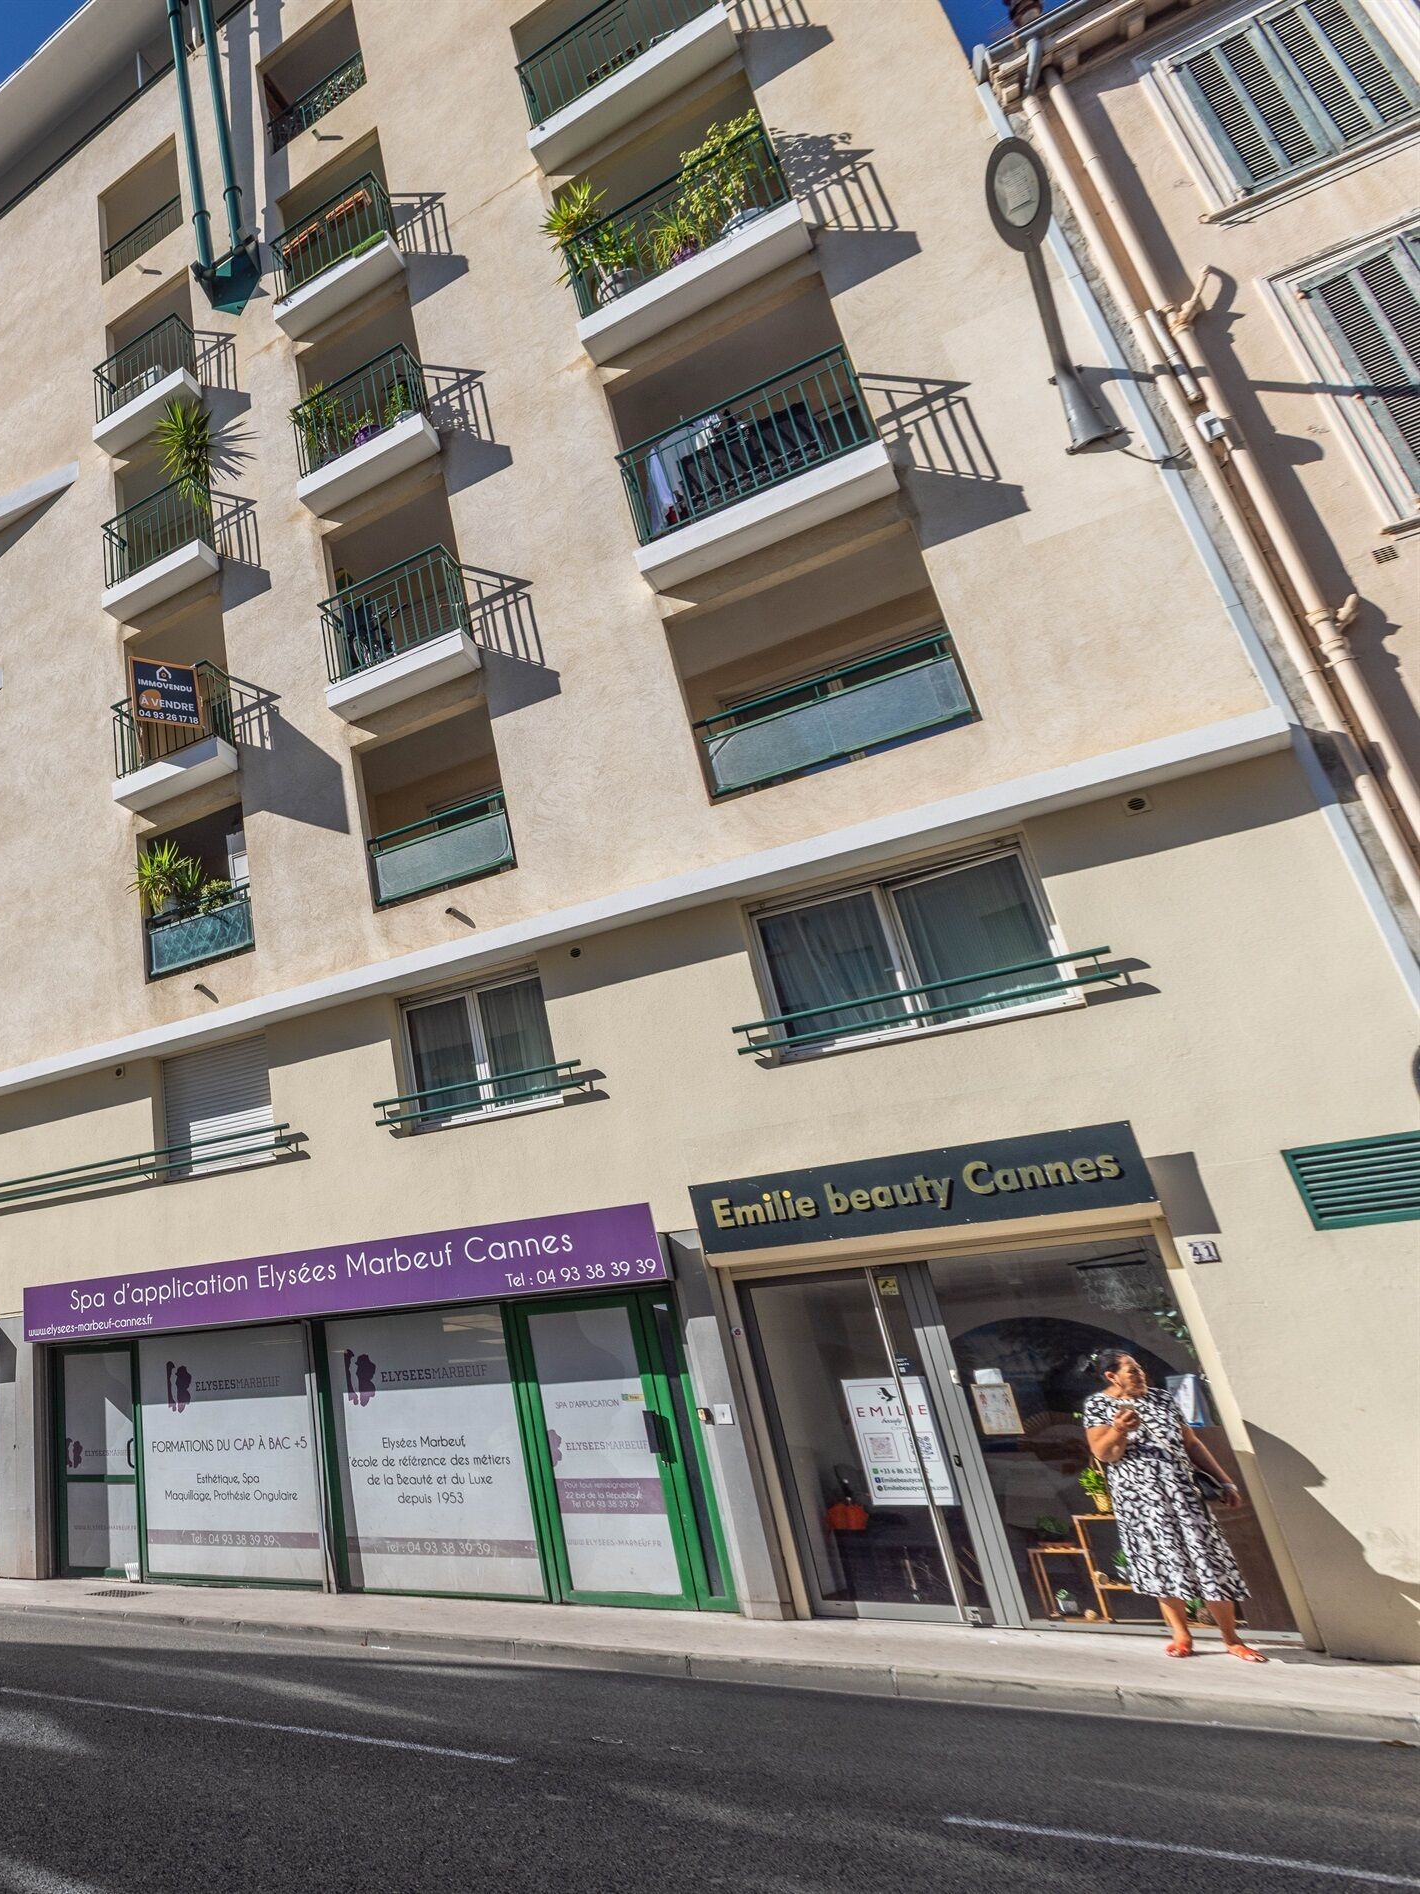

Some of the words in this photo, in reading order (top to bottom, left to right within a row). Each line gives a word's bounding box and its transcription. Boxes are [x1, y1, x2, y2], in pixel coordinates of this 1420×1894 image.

[138, 678, 192, 692] IMMOVENDU
[141, 694, 148, 705] À
[151, 698, 195, 712] VENDRE
[139, 709, 151, 718] 04
[152, 711, 164, 719] 93
[166, 713, 177, 721] 26
[189, 716, 198, 724] 18
[711, 1190, 816, 1228] Emilie
[824, 1174, 950, 1214] beauty
[962, 1154, 1120, 1194] Cannes
[1192, 1245, 1216, 1259] 41
[70, 1289, 105, 1313] Spa
[114, 1274, 248, 1306] d'application
[258, 1263, 336, 1291] Elysées
[346, 1242, 452, 1277] Marbeuf
[464, 1234, 573, 1263] Cannes
[505, 1273, 524, 1288] Tel
[536, 1269, 556, 1284] 04
[560, 1266, 580, 1282] 93
[586, 1264, 605, 1279] 38
[610, 1261, 630, 1276] 39
[636, 1258, 656, 1274] 39
[28, 1314, 153, 1336] www.elysees-marbeuf-cannes.fr
[381, 1364, 488, 1383] ELYSEESMARBEUF
[195, 1375, 281, 1392] ELYSEESMARBEUF
[555, 1401, 568, 1409] SPA
[569, 1399, 620, 1409] D'APPLICATION
[856, 1404, 928, 1418] EMILIE
[152, 1439, 214, 1453] FORMATIONS
[217, 1439, 230, 1452] DU
[234, 1438, 255, 1451] CAP
[258, 1434, 266, 1450] À
[269, 1436, 291, 1450] BAC
[294, 1436, 308, 1449] +5
[382, 1437, 417, 1450] Elysées
[382, 1456, 395, 1467] de
[398, 1454, 446, 1467] référence
[450, 1454, 470, 1465] des
[473, 1454, 511, 1465] métiers
[196, 1473, 240, 1486] Esthétique,
[242, 1473, 260, 1485] Spa
[367, 1475, 380, 1485] de
[383, 1474, 394, 1485] la
[397, 1473, 433, 1485] Beauté
[436, 1475, 447, 1485] et
[451, 1474, 465, 1485] du
[468, 1473, 493, 1485] Luxe
[564, 1481, 578, 1489] Pour
[165, 1490, 212, 1502] Maquillage,
[214, 1490, 251, 1501] Prothésie
[254, 1490, 298, 1502] Ongulaire
[398, 1492, 432, 1506] depuis
[437, 1492, 464, 1504] 1953
[565, 1491, 575, 1499] 22
[585, 1491, 595, 1499] de
[597, 1491, 605, 1499] la
[585, 1500, 595, 1508] 04
[597, 1500, 606, 1508] 93
[608, 1500, 618, 1508] 38
[619, 1500, 628, 1508] 39
[630, 1500, 639, 1508] 39
[191, 1533, 202, 1544] Tel
[208, 1534, 219, 1545] 04
[221, 1534, 233, 1545] 93
[235, 1535, 247, 1545] 38
[250, 1535, 261, 1545] 39
[263, 1535, 275, 1546] 39
[386, 1542, 399, 1553] Tel
[407, 1542, 420, 1553] 04
[423, 1543, 438, 1554] 93
[441, 1543, 455, 1554] 38
[459, 1543, 472, 1554] 39
[477, 1544, 491, 1555] 39
